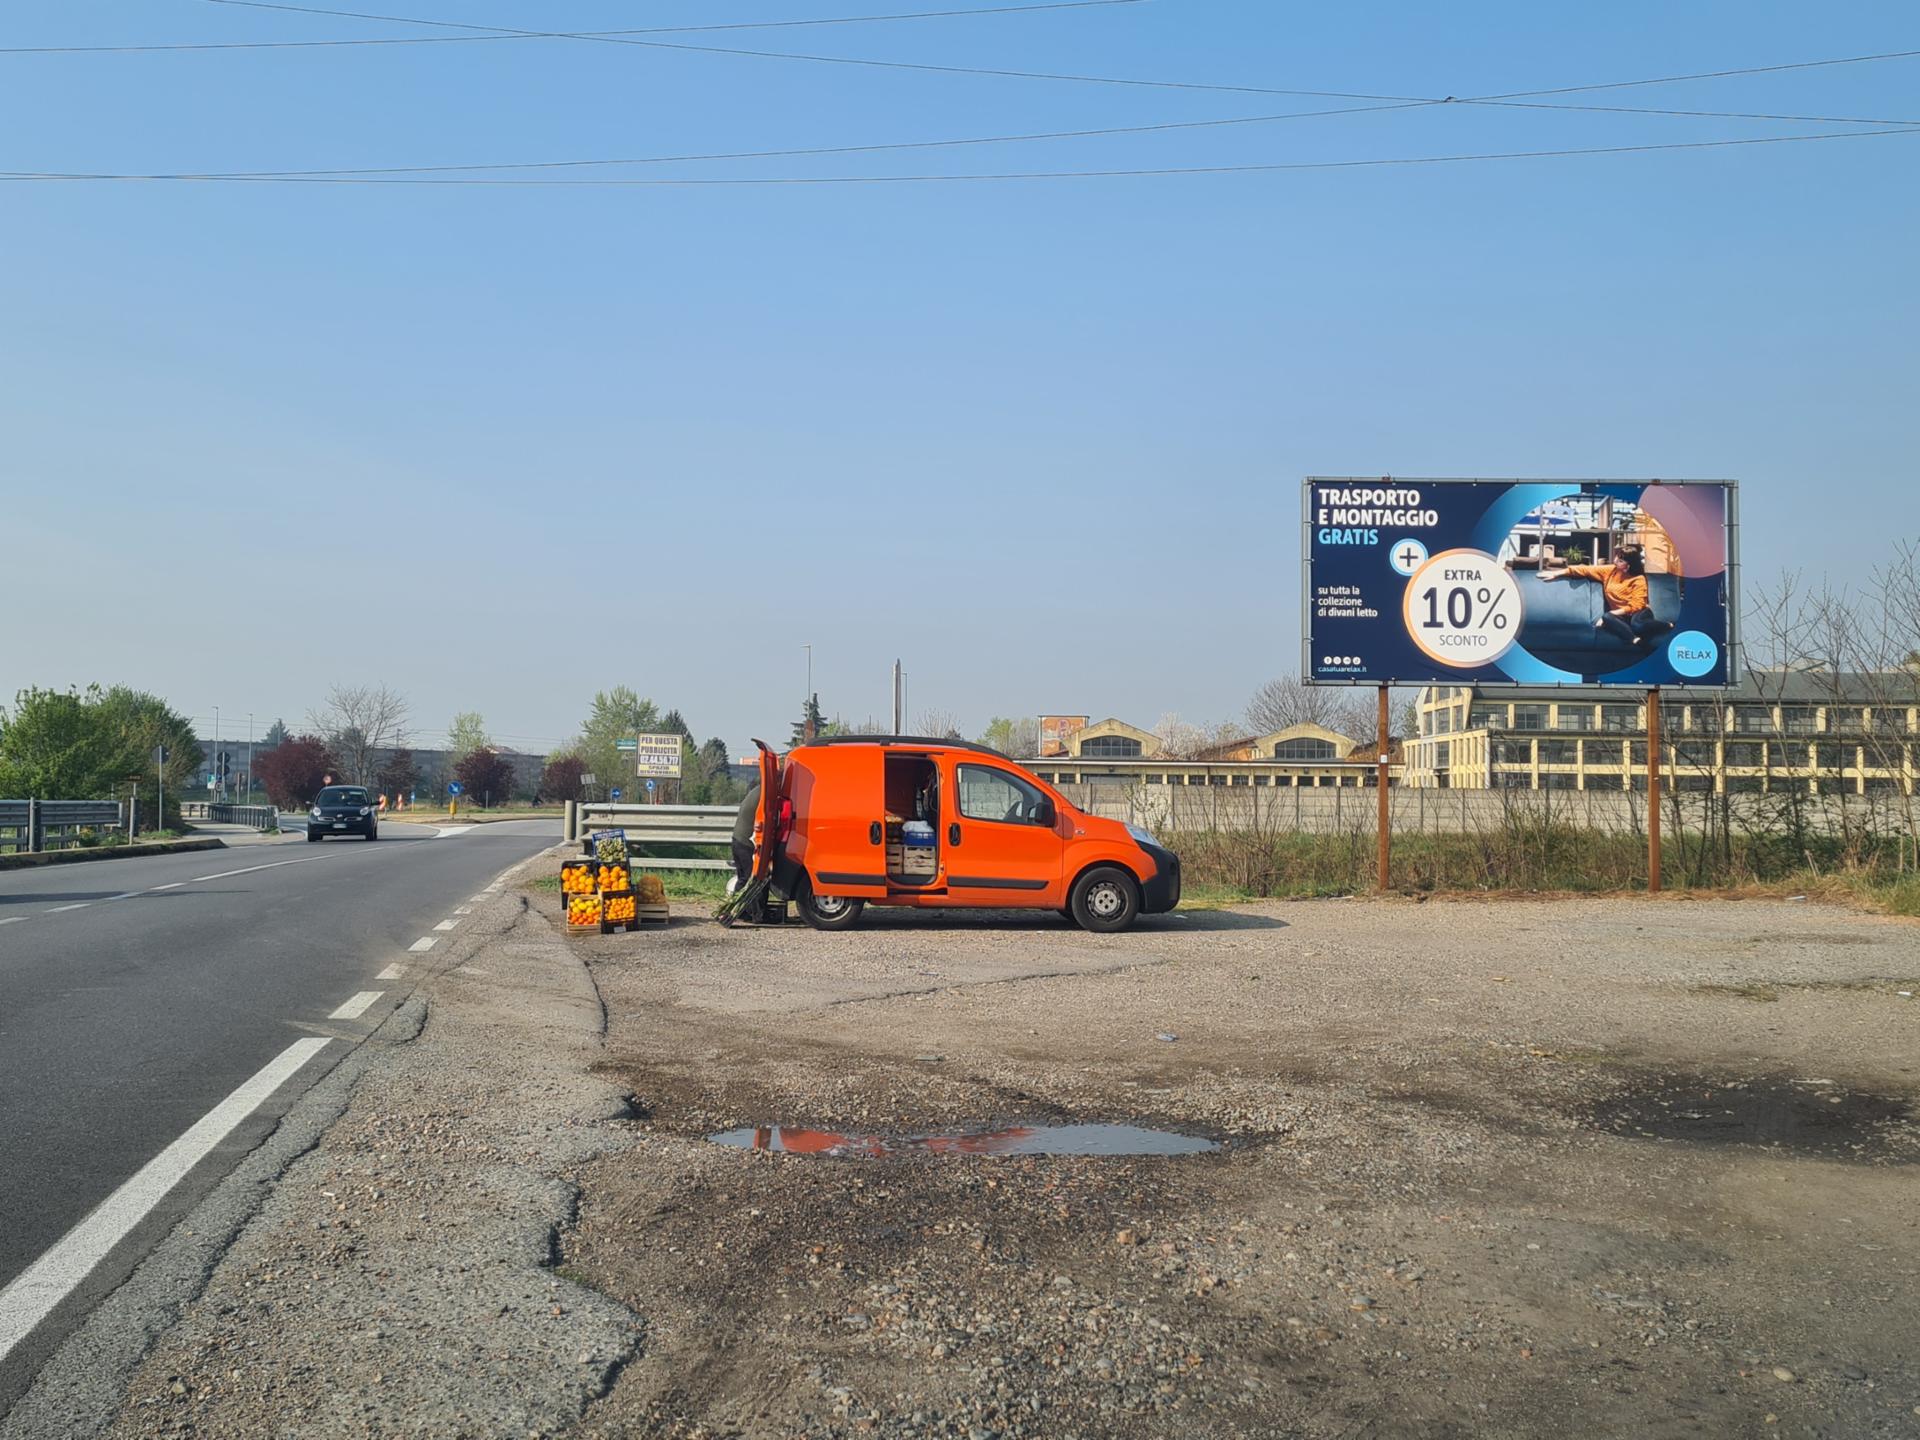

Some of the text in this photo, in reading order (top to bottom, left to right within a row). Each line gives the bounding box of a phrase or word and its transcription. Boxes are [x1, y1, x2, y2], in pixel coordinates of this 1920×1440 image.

[1318, 488, 1421, 506] TRASPORTO
[1318, 508, 1439, 526] E MONTAGGIO
[1318, 528, 1379, 545] GRATIS
[1444, 570, 1482, 581] EXTRA
[1318, 586, 1360, 595] su tutta la
[1318, 596, 1363, 606] collezione
[1318, 607, 1378, 617] di divani letto
[1422, 586, 1507, 630] 10%
[1439, 634, 1488, 647] SCONTO
[1677, 650, 1712, 660] RELAX
[1317, 665, 1367, 673] casatuarelax.it
[654, 737, 678, 745] QUESTA
